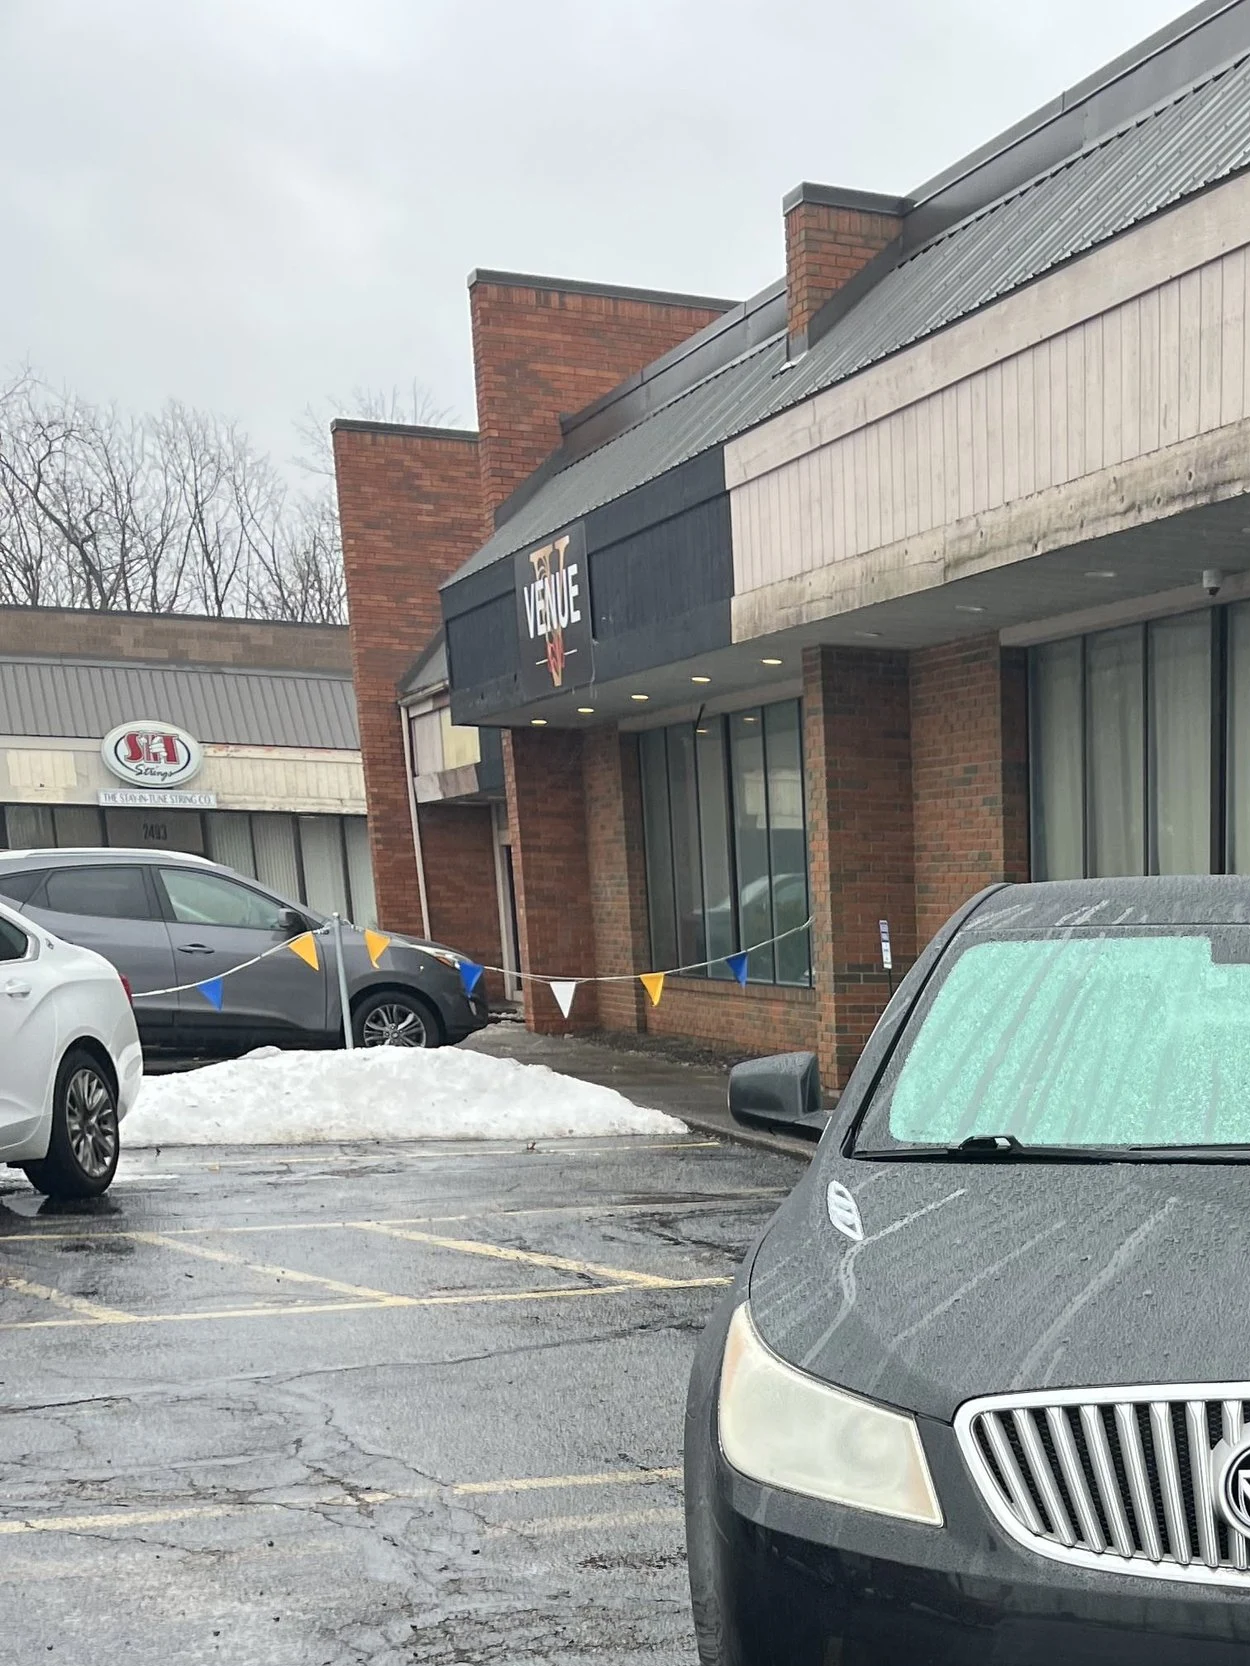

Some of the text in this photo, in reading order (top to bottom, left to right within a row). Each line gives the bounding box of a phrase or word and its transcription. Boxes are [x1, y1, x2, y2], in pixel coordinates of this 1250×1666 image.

[524, 563, 581, 639] VENUE
[134, 763, 174, 781] Strings
[104, 793, 118, 803] THE
[170, 794, 198, 805] STRING
